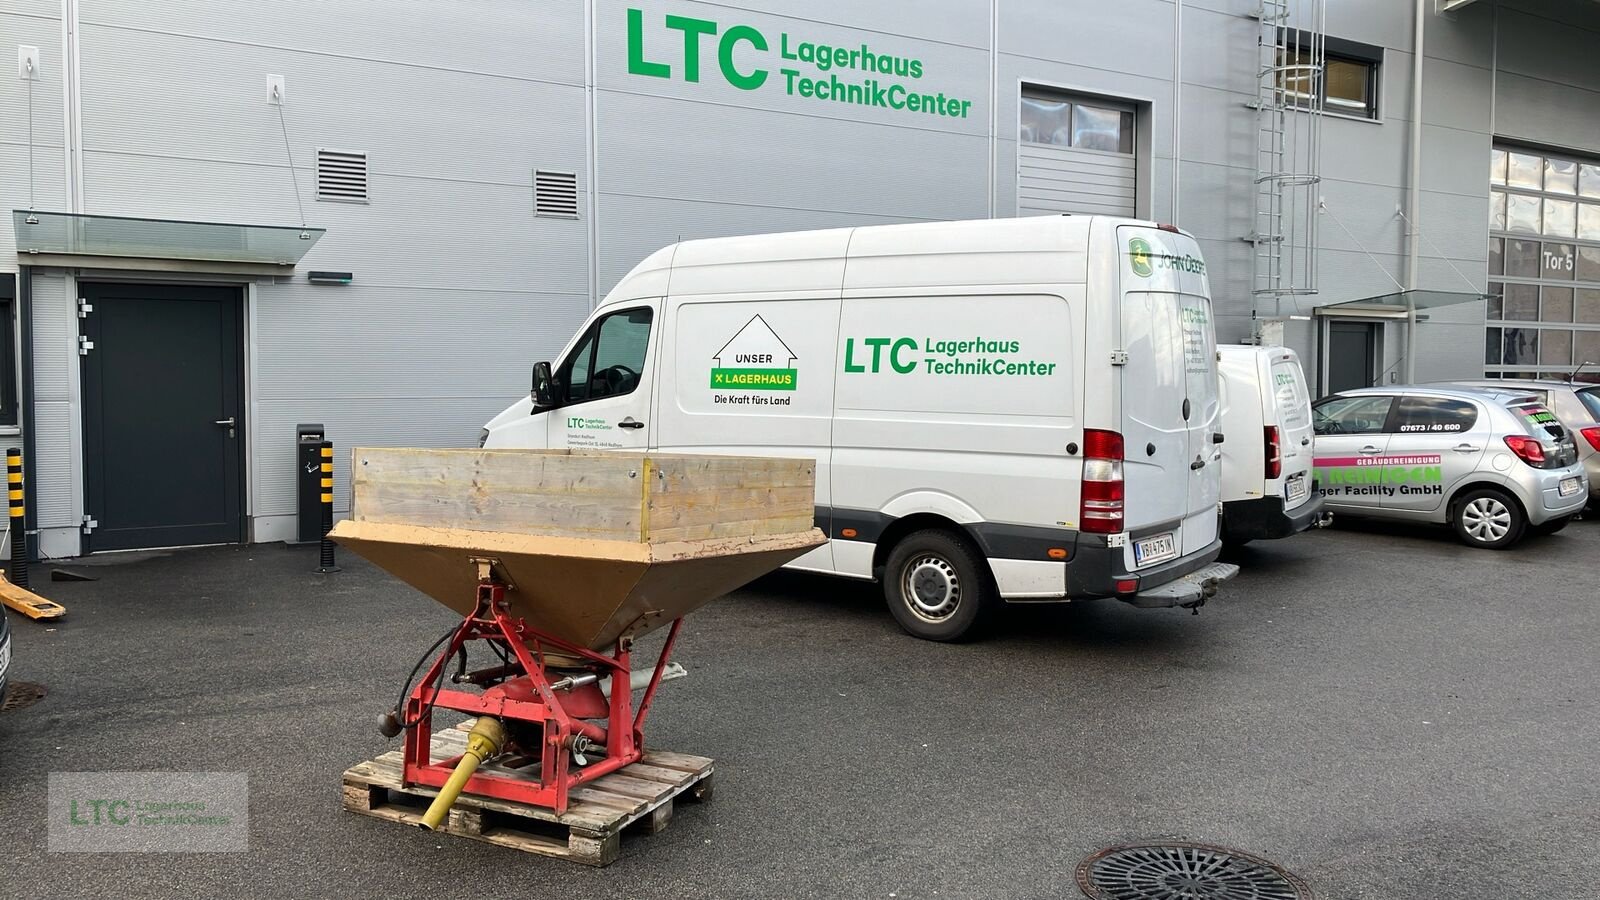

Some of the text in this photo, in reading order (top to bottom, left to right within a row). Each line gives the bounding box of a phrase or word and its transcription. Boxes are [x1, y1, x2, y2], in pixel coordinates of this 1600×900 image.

[627, 8, 769, 91] LTC
[781, 32, 923, 79] Lagerhaus
[780, 68, 971, 119] TechnikCenter
[1543, 251, 1573, 271] Tor 5
[925, 336, 1020, 357] Lagerhaus
[735, 354, 773, 364] UNSER
[844, 337, 919, 375] LTC
[924, 358, 1056, 376] TechnikCenter
[725, 374, 792, 385] LAGERHAUS
[714, 394, 791, 406] Die Kraft fürs Land
[567, 418, 585, 428] LTC
[1400, 424, 1426, 432] 07673
[1444, 423, 1461, 431] 600
[1357, 457, 1440, 466] GEBÄUDEREINIGUNG
[1329, 466, 1442, 484] REINIGEN
[1319, 485, 1442, 497] ger Facility GmbH
[1153, 539, 1165, 555] 475
